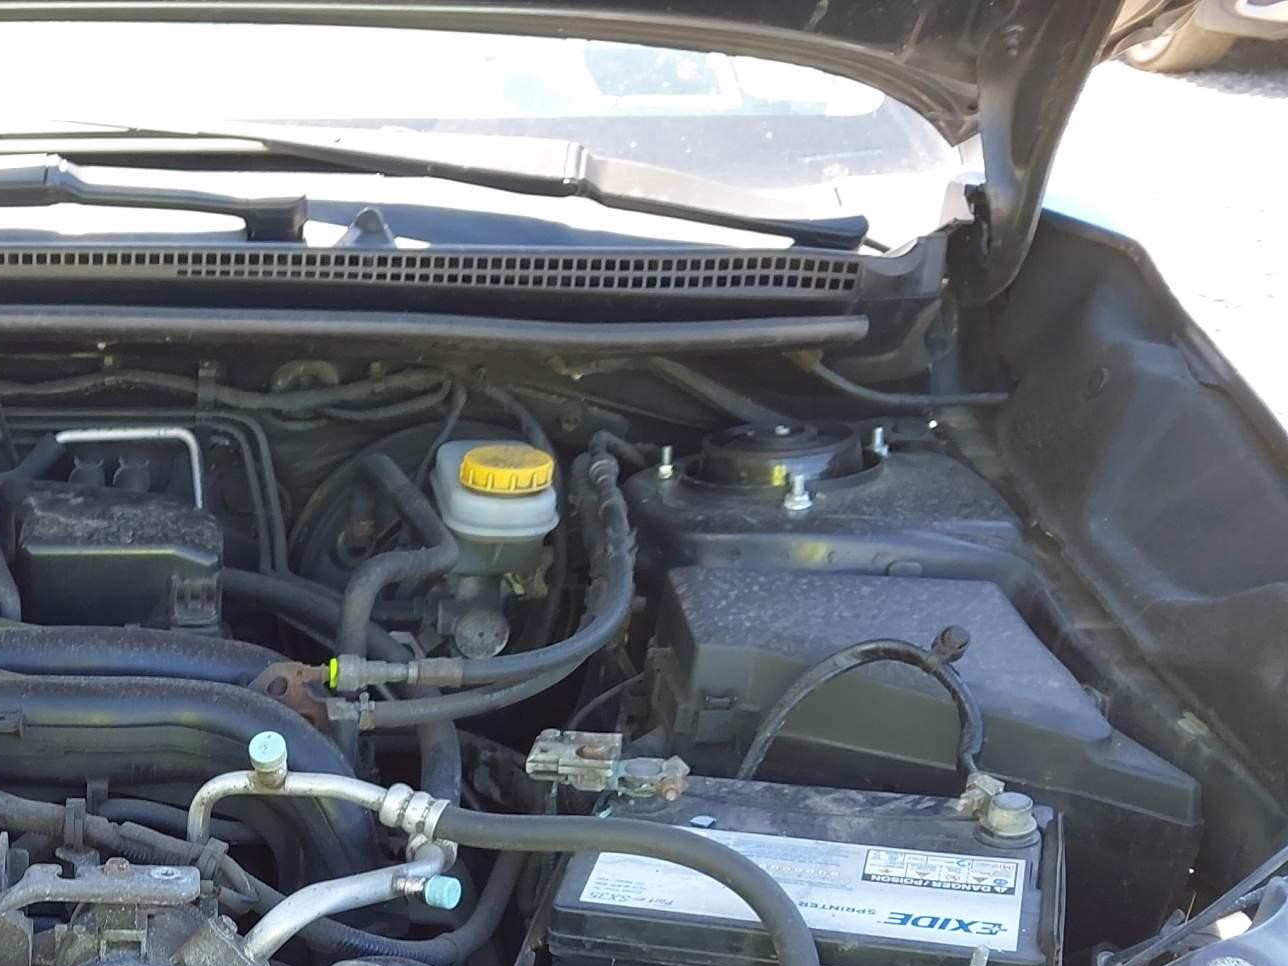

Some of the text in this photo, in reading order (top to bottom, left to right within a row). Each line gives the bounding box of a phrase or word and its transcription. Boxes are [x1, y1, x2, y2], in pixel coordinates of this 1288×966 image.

[871, 874, 922, 886] POISON
[932, 881, 991, 893] DANGER
[798, 901, 1008, 936] EXIDE SPRINTER
